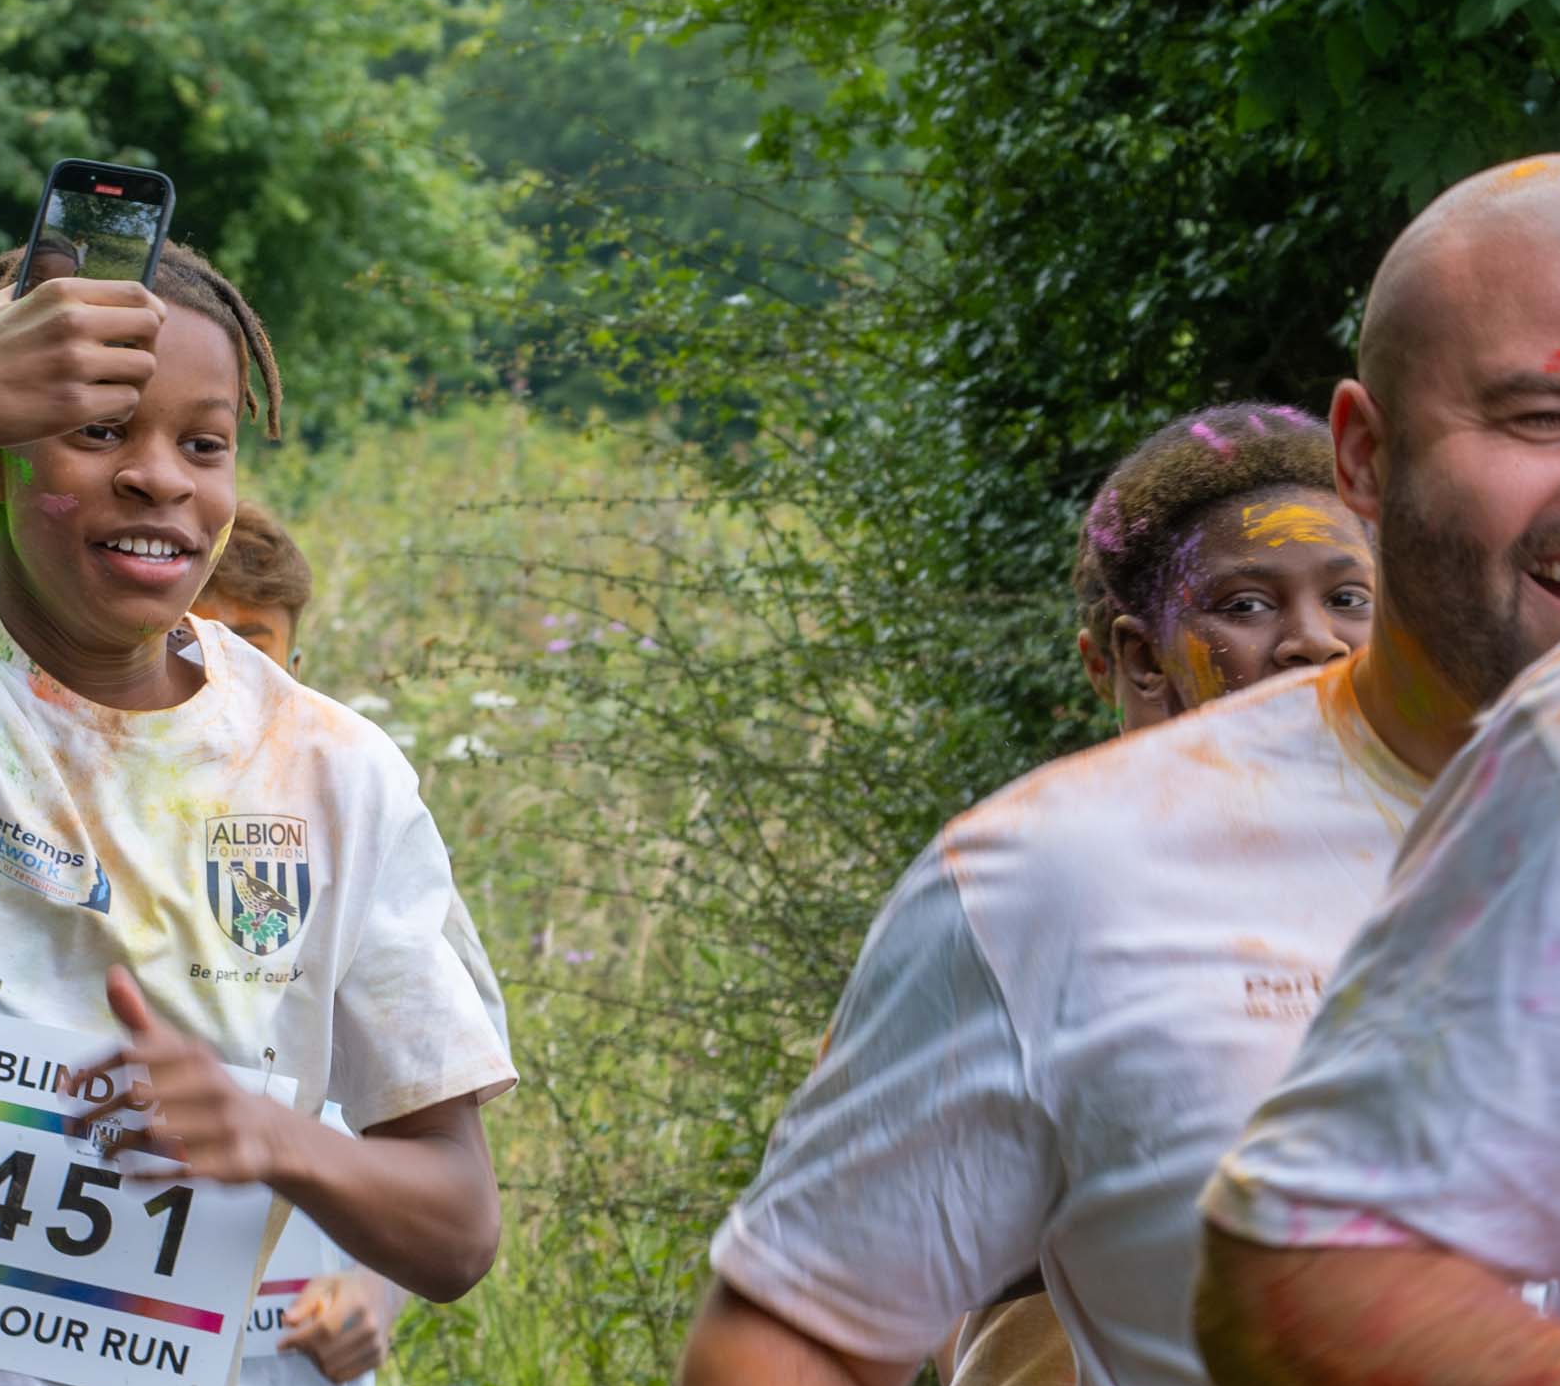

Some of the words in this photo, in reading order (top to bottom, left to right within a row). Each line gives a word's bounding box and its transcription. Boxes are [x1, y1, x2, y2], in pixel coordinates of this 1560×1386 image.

[212, 823, 302, 846] ALBION
[210, 846, 303, 859] FOUNDATION
[190, 964, 211, 979] Be
[215, 968, 239, 984] part
[244, 967, 261, 982] of
[265, 971, 288, 983] our
[100, 1327, 190, 1376] RUN
